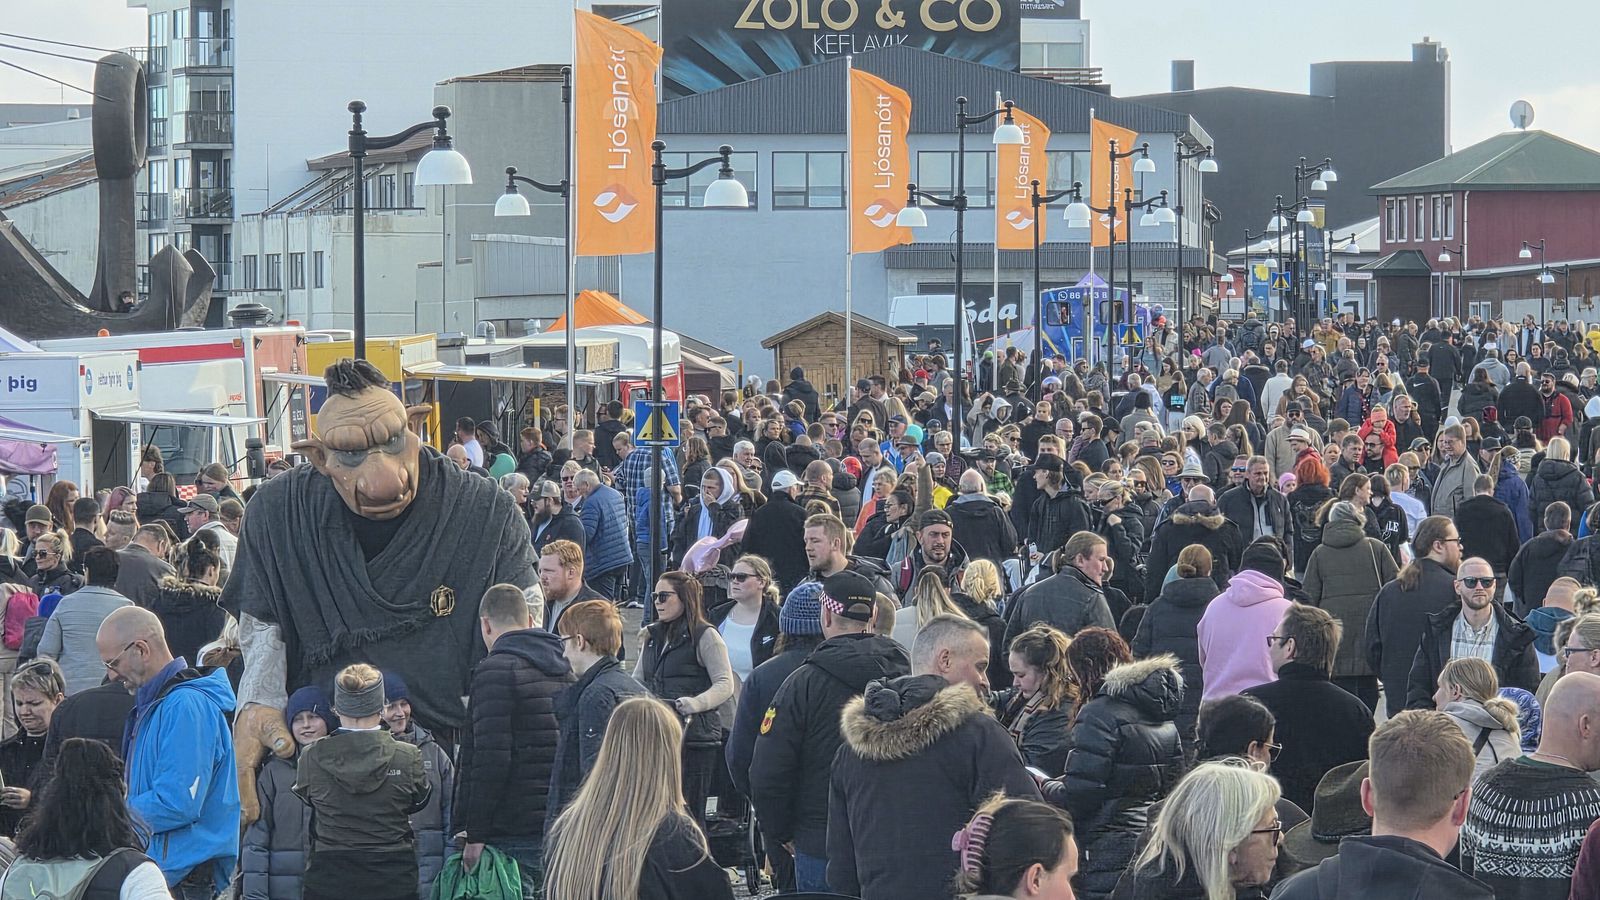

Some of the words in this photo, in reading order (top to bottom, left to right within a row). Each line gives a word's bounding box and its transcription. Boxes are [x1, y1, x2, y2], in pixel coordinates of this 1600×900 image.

[734, 0, 859, 31] ZOLO
[875, 0, 906, 30] &
[919, 0, 1002, 32] CO
[813, 33, 909, 54] KEFLAVIK
[607, 44, 632, 169] Ljósanótt
[873, 94, 895, 188] Ljósanótt
[8, 375, 38, 392] þig
